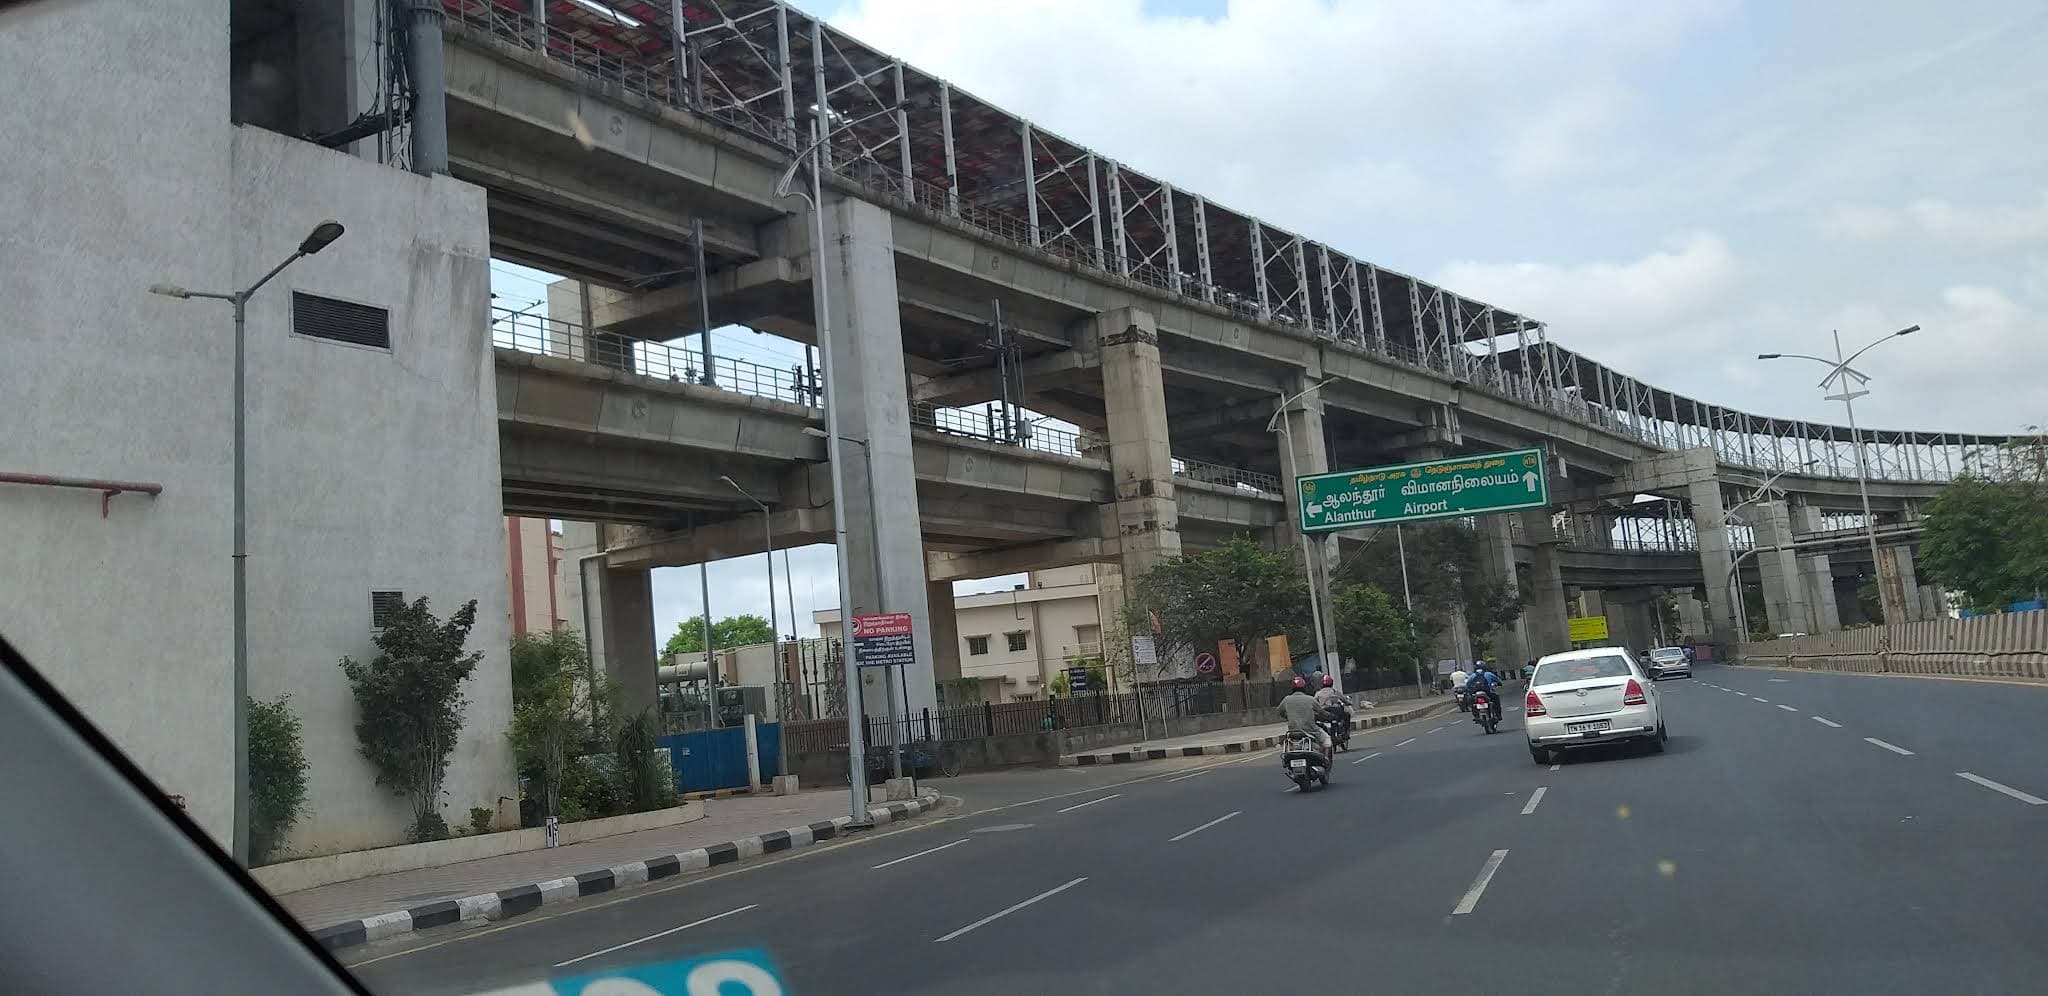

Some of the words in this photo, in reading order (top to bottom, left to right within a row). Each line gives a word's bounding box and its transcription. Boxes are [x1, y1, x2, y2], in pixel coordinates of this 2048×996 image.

[1401, 469, 1519, 495] விமானநிலையம்
[1322, 485, 1385, 509] ஆலந்தூர்
[1325, 509, 1376, 523] Alanthur
[1404, 500, 1448, 515] Airport
